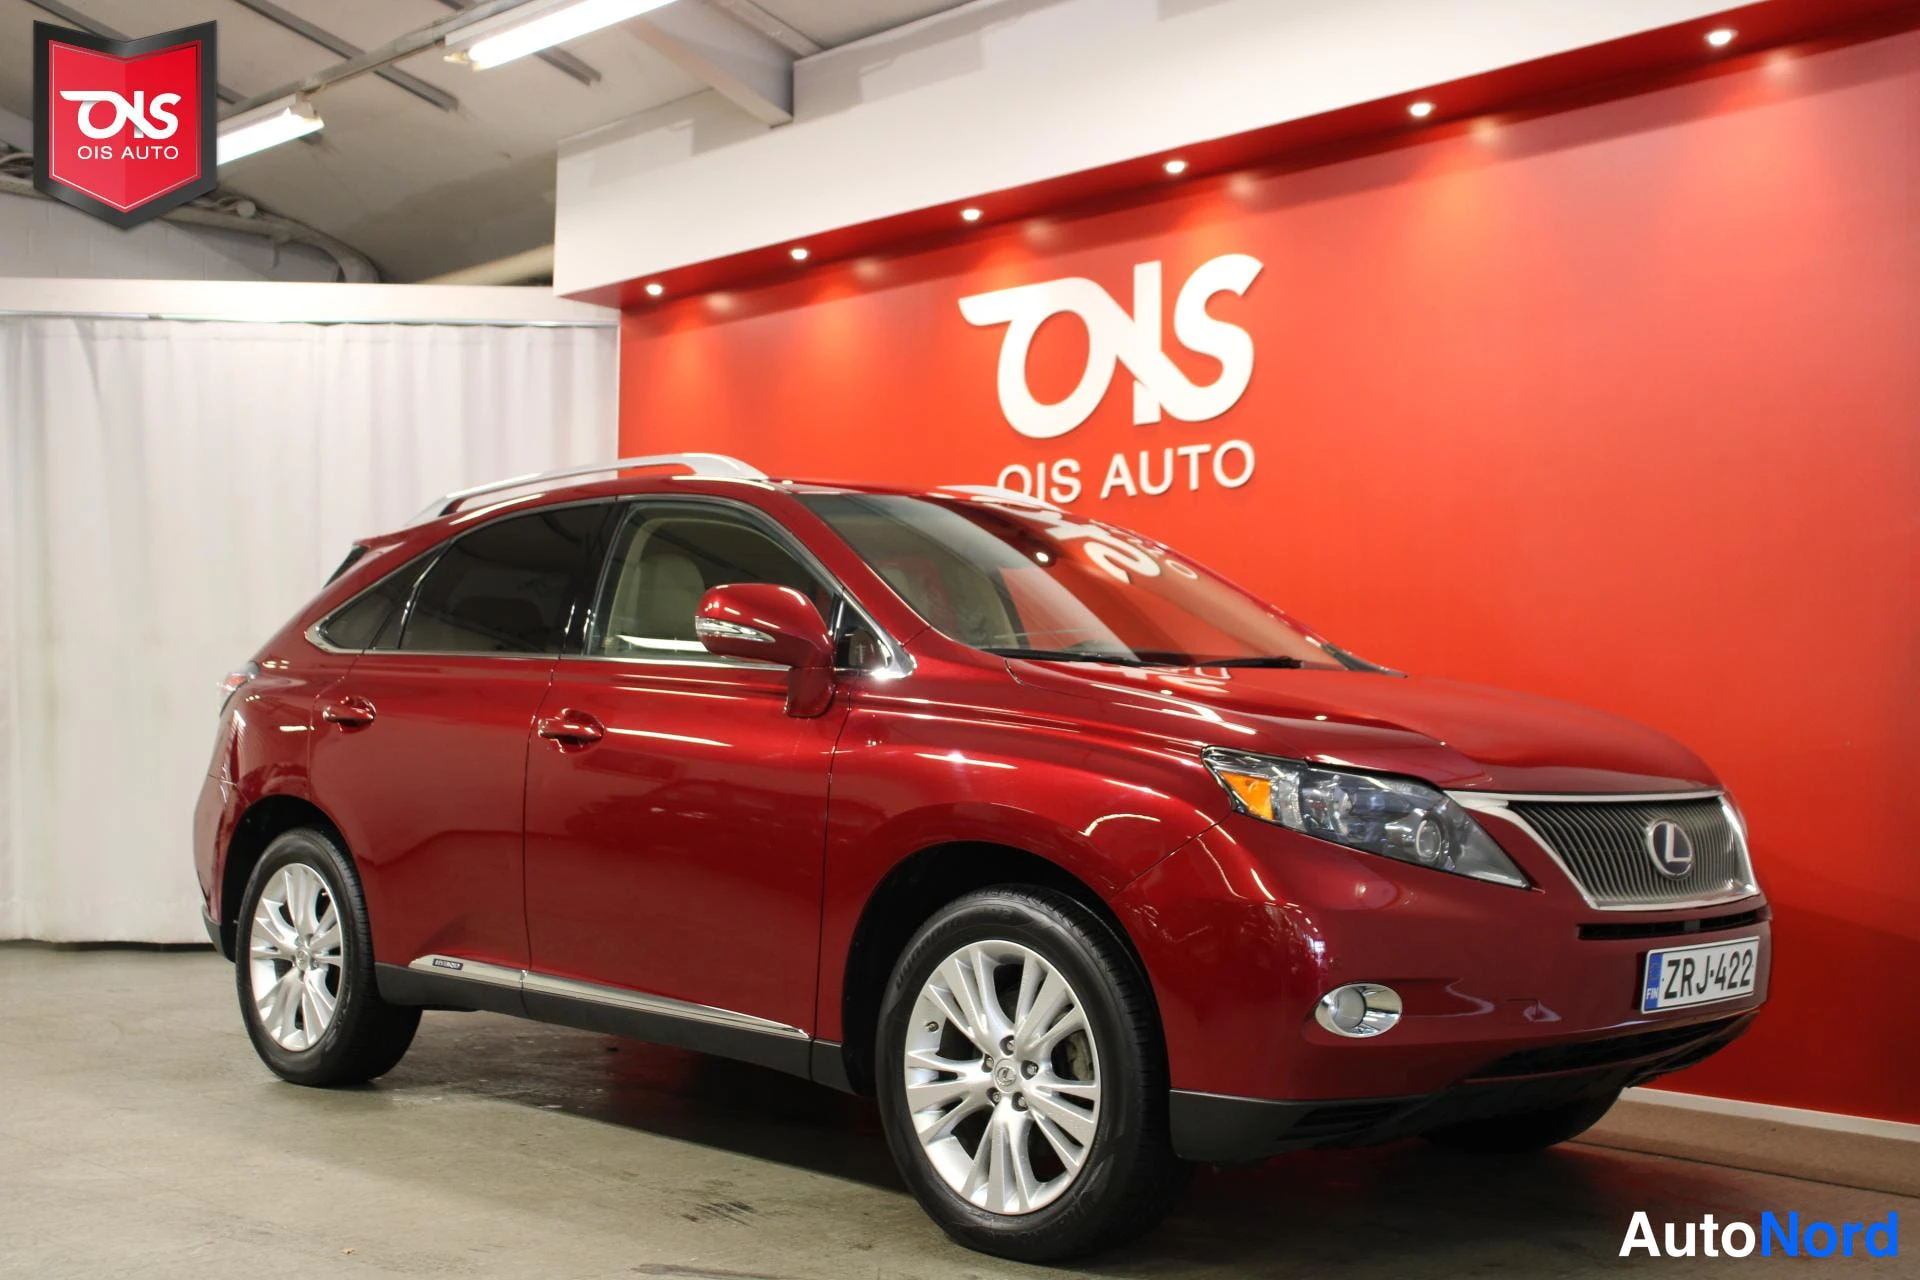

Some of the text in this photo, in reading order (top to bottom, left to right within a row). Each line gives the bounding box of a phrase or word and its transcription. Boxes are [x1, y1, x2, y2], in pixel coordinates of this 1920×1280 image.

[997, 439, 1256, 504] OIS AUTO
[1646, 986, 1660, 1000] FIN
[1663, 948, 1754, 1000] ZRJ-422
